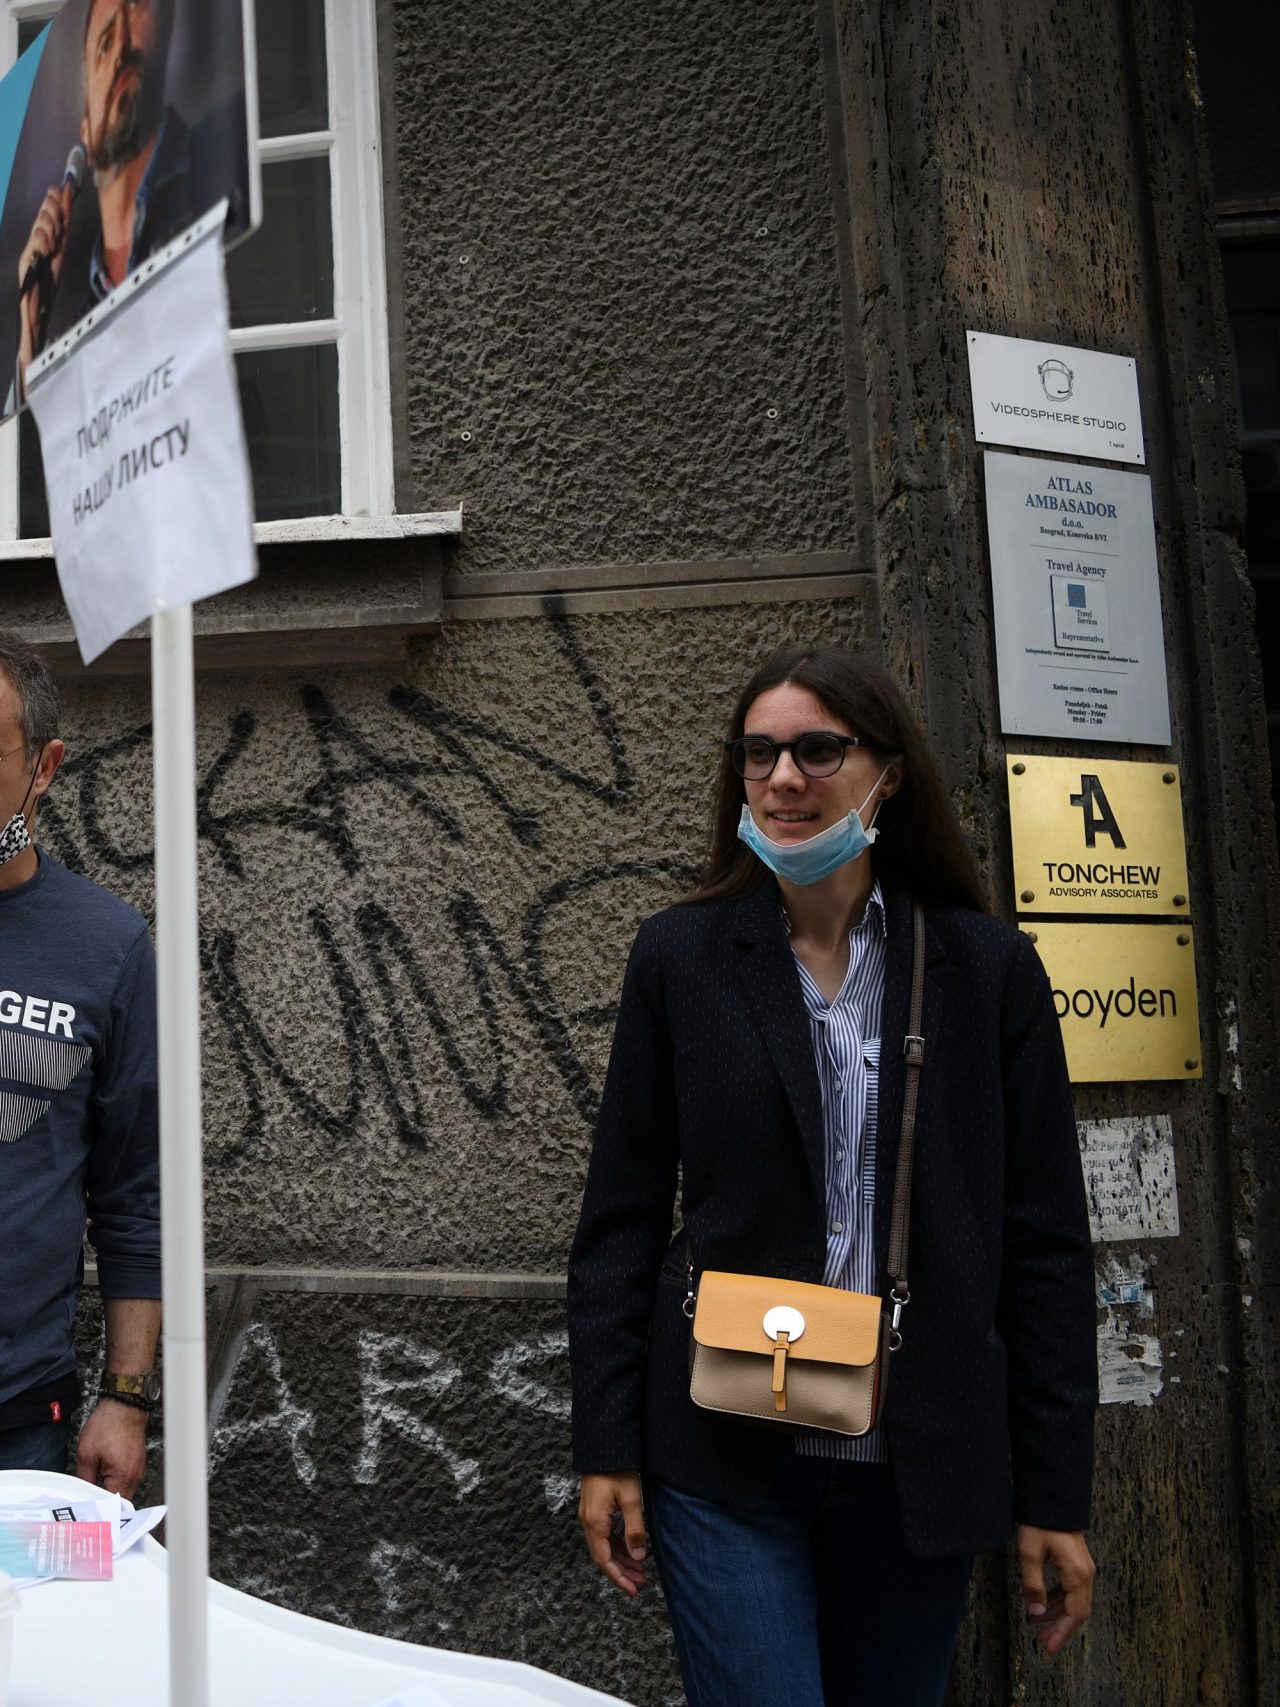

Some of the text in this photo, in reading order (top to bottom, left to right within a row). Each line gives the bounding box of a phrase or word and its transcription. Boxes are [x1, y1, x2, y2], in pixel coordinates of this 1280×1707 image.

[76, 356, 175, 459] ПОДРЖИТЕ
[990, 401, 1127, 432] VIDEOSPHERE STUDIO
[73, 418, 190, 526] НАШУ ЛИСТУ
[1047, 476, 1093, 495] ATLAS
[1025, 493, 1118, 519] AMBASADOR
[1061, 517, 1084, 529] d.o.o.
[1046, 559, 1106, 578] Travel Agency
[1062, 632, 1104, 643] Representative
[1043, 862, 1161, 885] TONCHEW
[1049, 887, 1158, 899] ADVISORY ASSOCIATES
